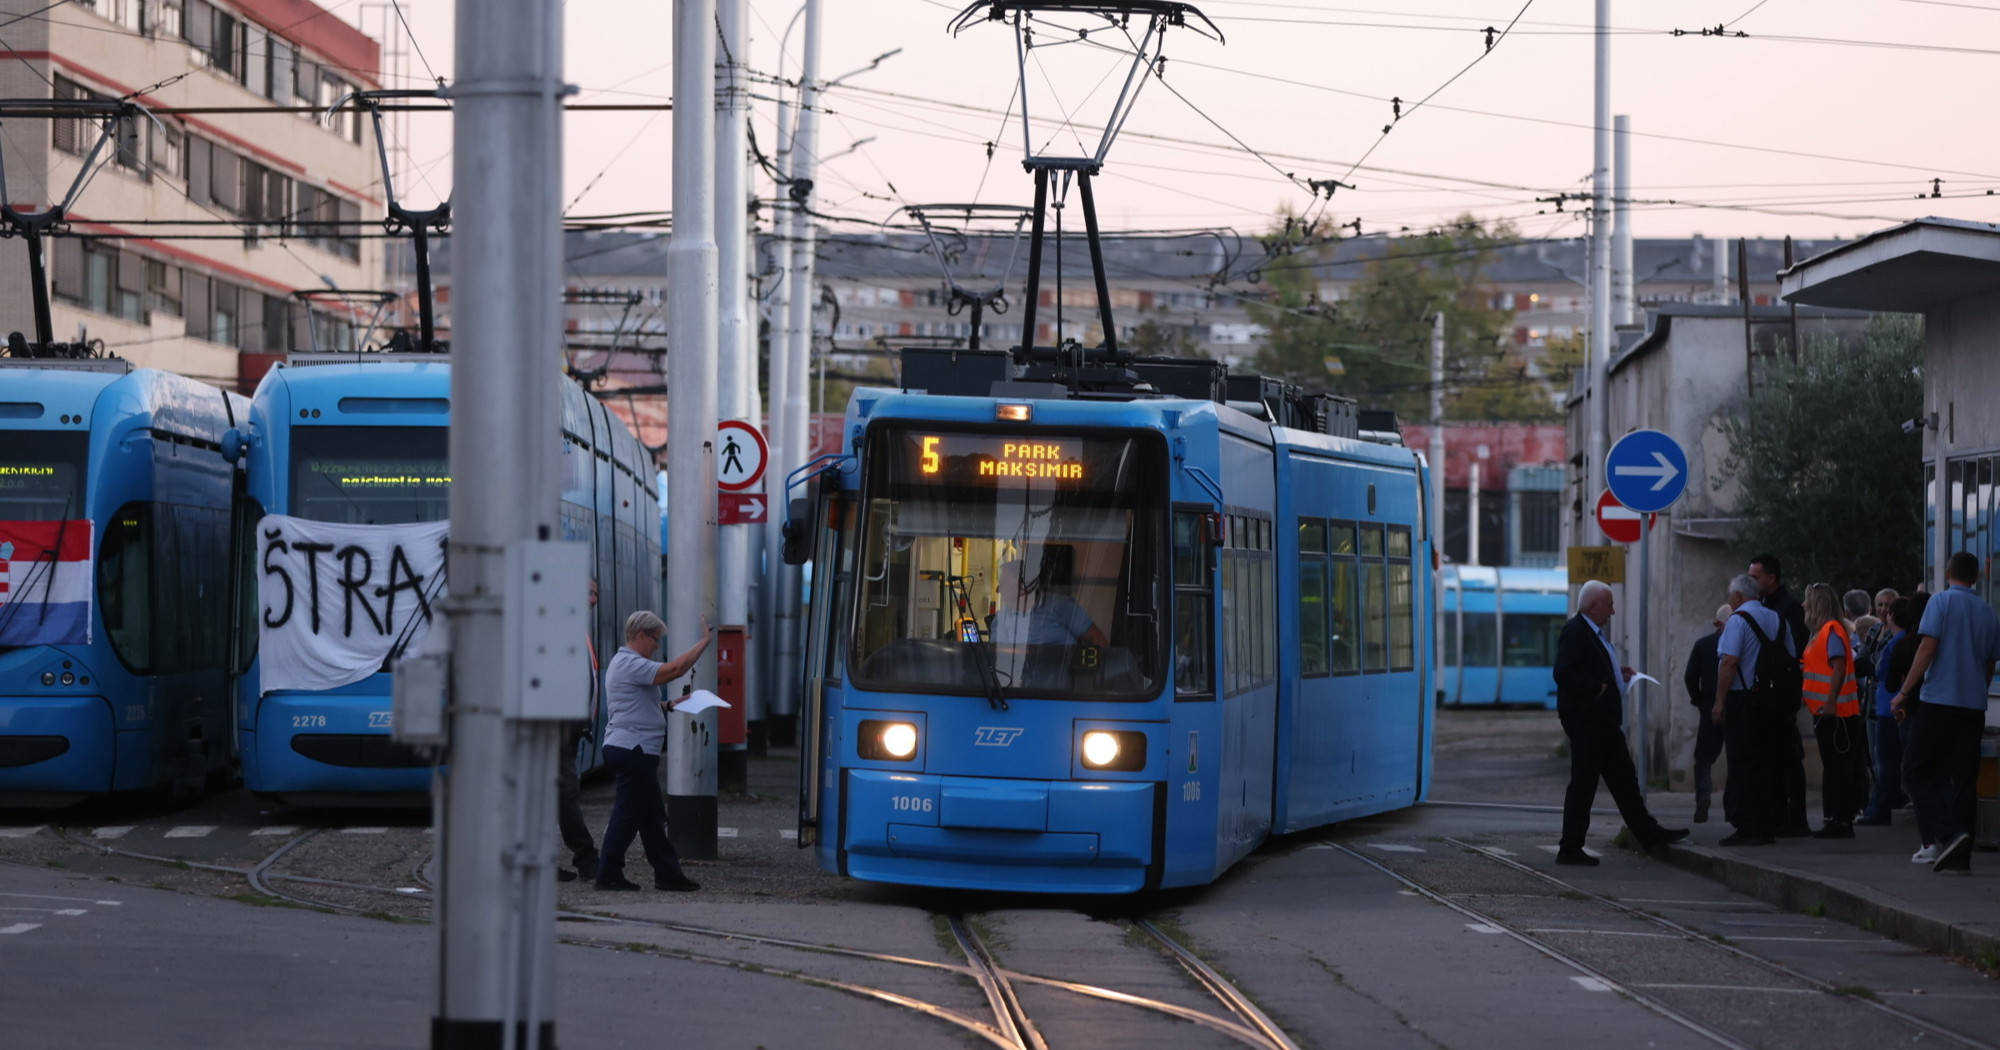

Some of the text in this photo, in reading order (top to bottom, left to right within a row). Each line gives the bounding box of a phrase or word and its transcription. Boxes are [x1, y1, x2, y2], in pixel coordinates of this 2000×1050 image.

[922, 437, 940, 473] 5
[1004, 443, 1060, 460] PARK
[980, 461, 1082, 479] MAKSIMIR
[264, 528, 449, 638] ŠTRA
[1082, 647, 1098, 667] 13
[292, 715, 326, 728] 2278
[975, 726, 1025, 747] ZET
[1183, 781, 1201, 802] 1006
[891, 795, 933, 812] 1006
